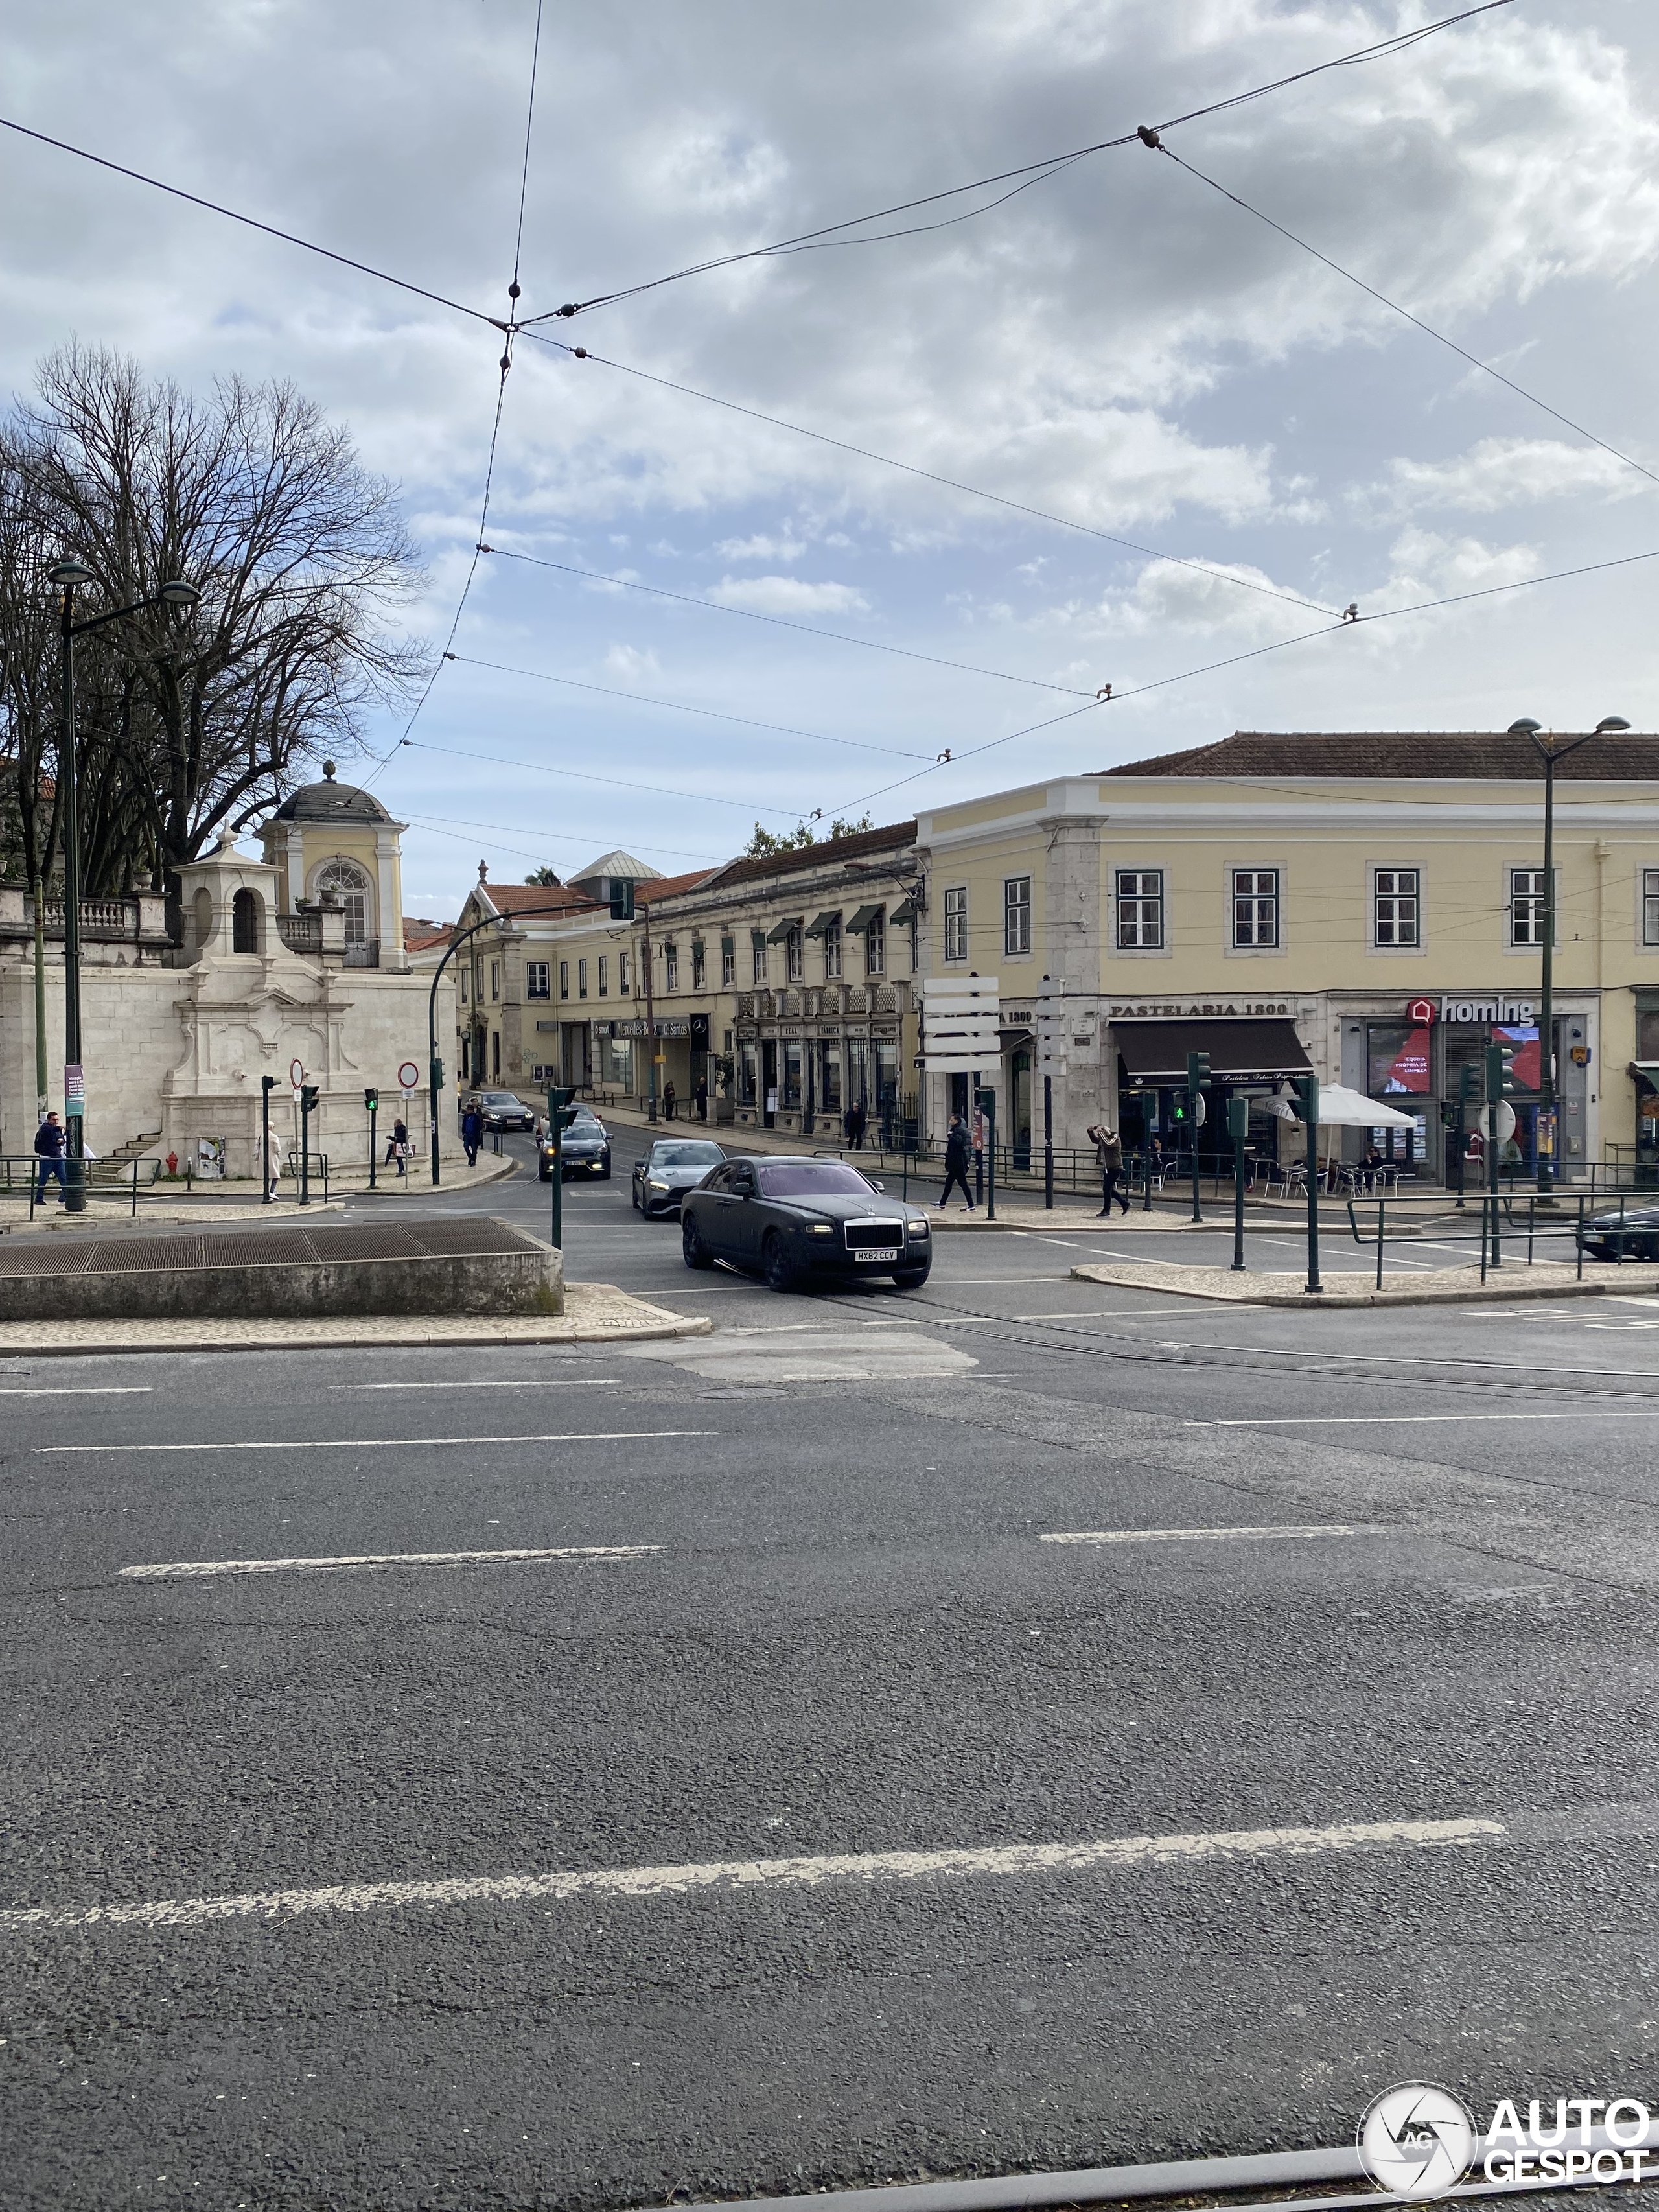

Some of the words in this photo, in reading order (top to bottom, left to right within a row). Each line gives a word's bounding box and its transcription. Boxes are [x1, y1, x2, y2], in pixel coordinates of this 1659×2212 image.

[1111, 1005, 1237, 1016] PASTELARIA
[1246, 1004, 1288, 1015] 1800
[1441, 995, 1535, 1028] homing
[1008, 1012, 1032, 1023] 1800
[618, 1021, 657, 1036] Mercedes-Bz
[670, 1023, 688, 1036] Santos
[858, 1252, 878, 1260] HX62
[880, 1251, 894, 1259] CCV
